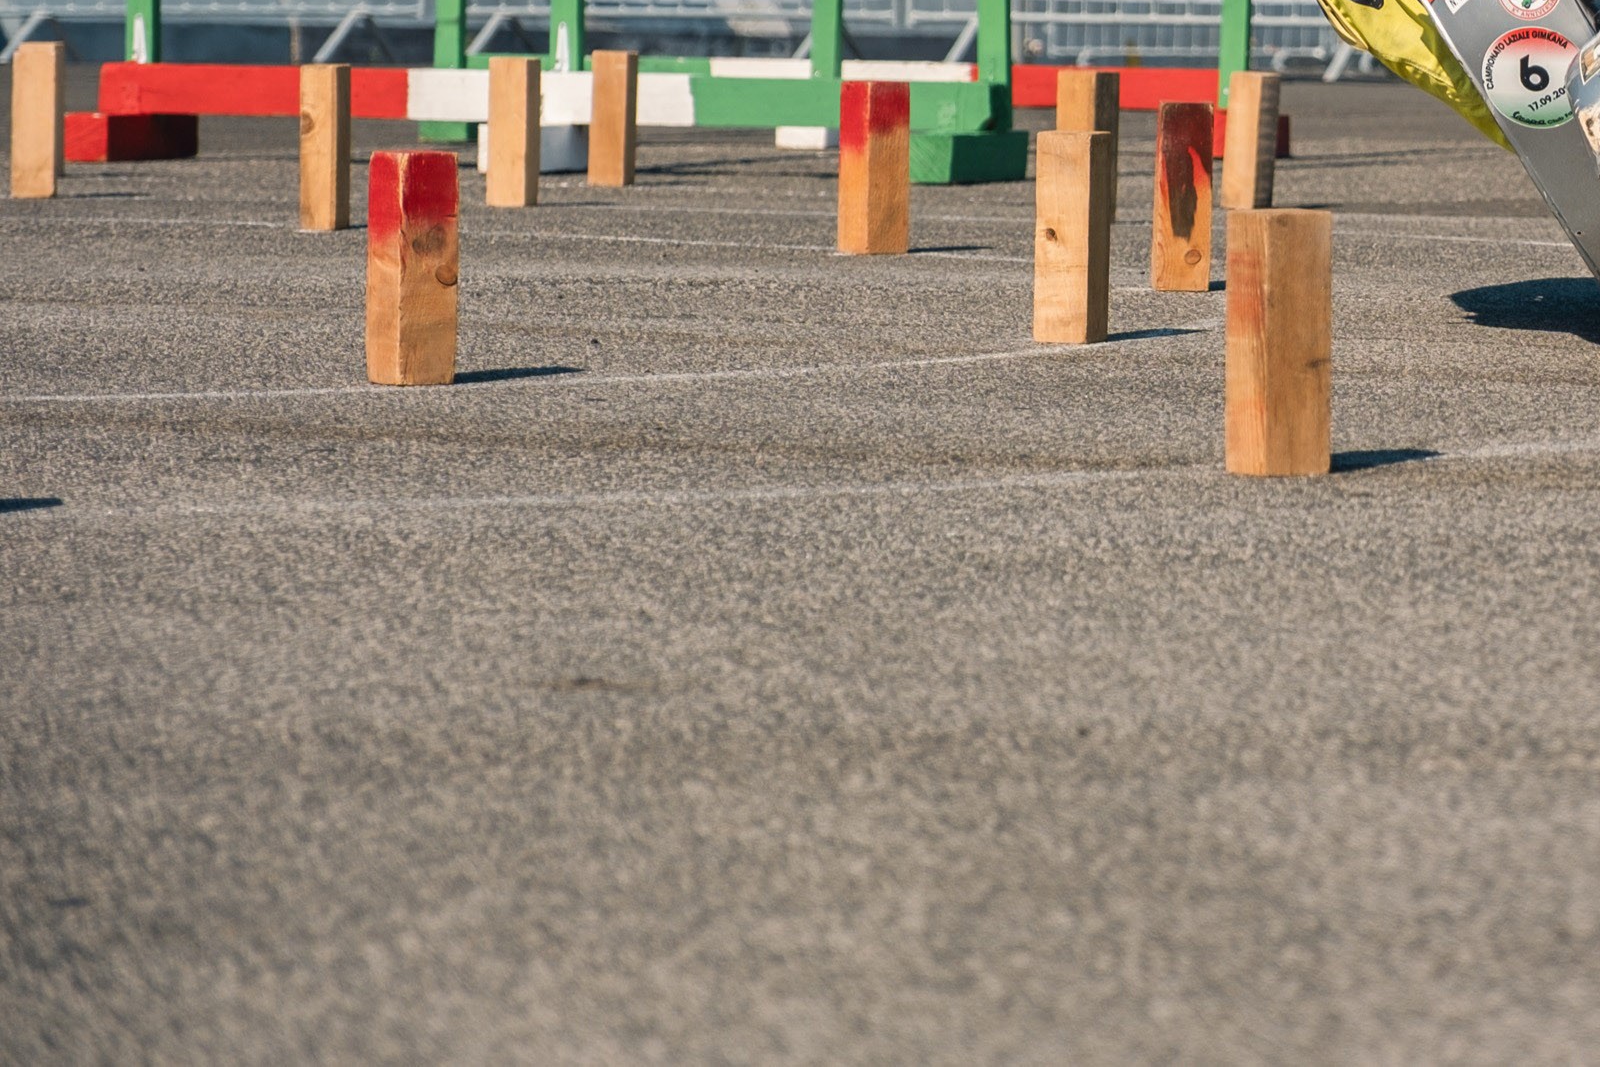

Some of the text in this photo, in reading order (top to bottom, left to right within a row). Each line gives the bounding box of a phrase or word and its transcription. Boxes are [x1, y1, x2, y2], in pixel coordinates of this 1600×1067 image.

[1484, 30, 1569, 90] CAMPIONATO LAZIALE GIMKANA
[1520, 54, 1550, 92] 6
[1527, 85, 1567, 112] 17.09.20
